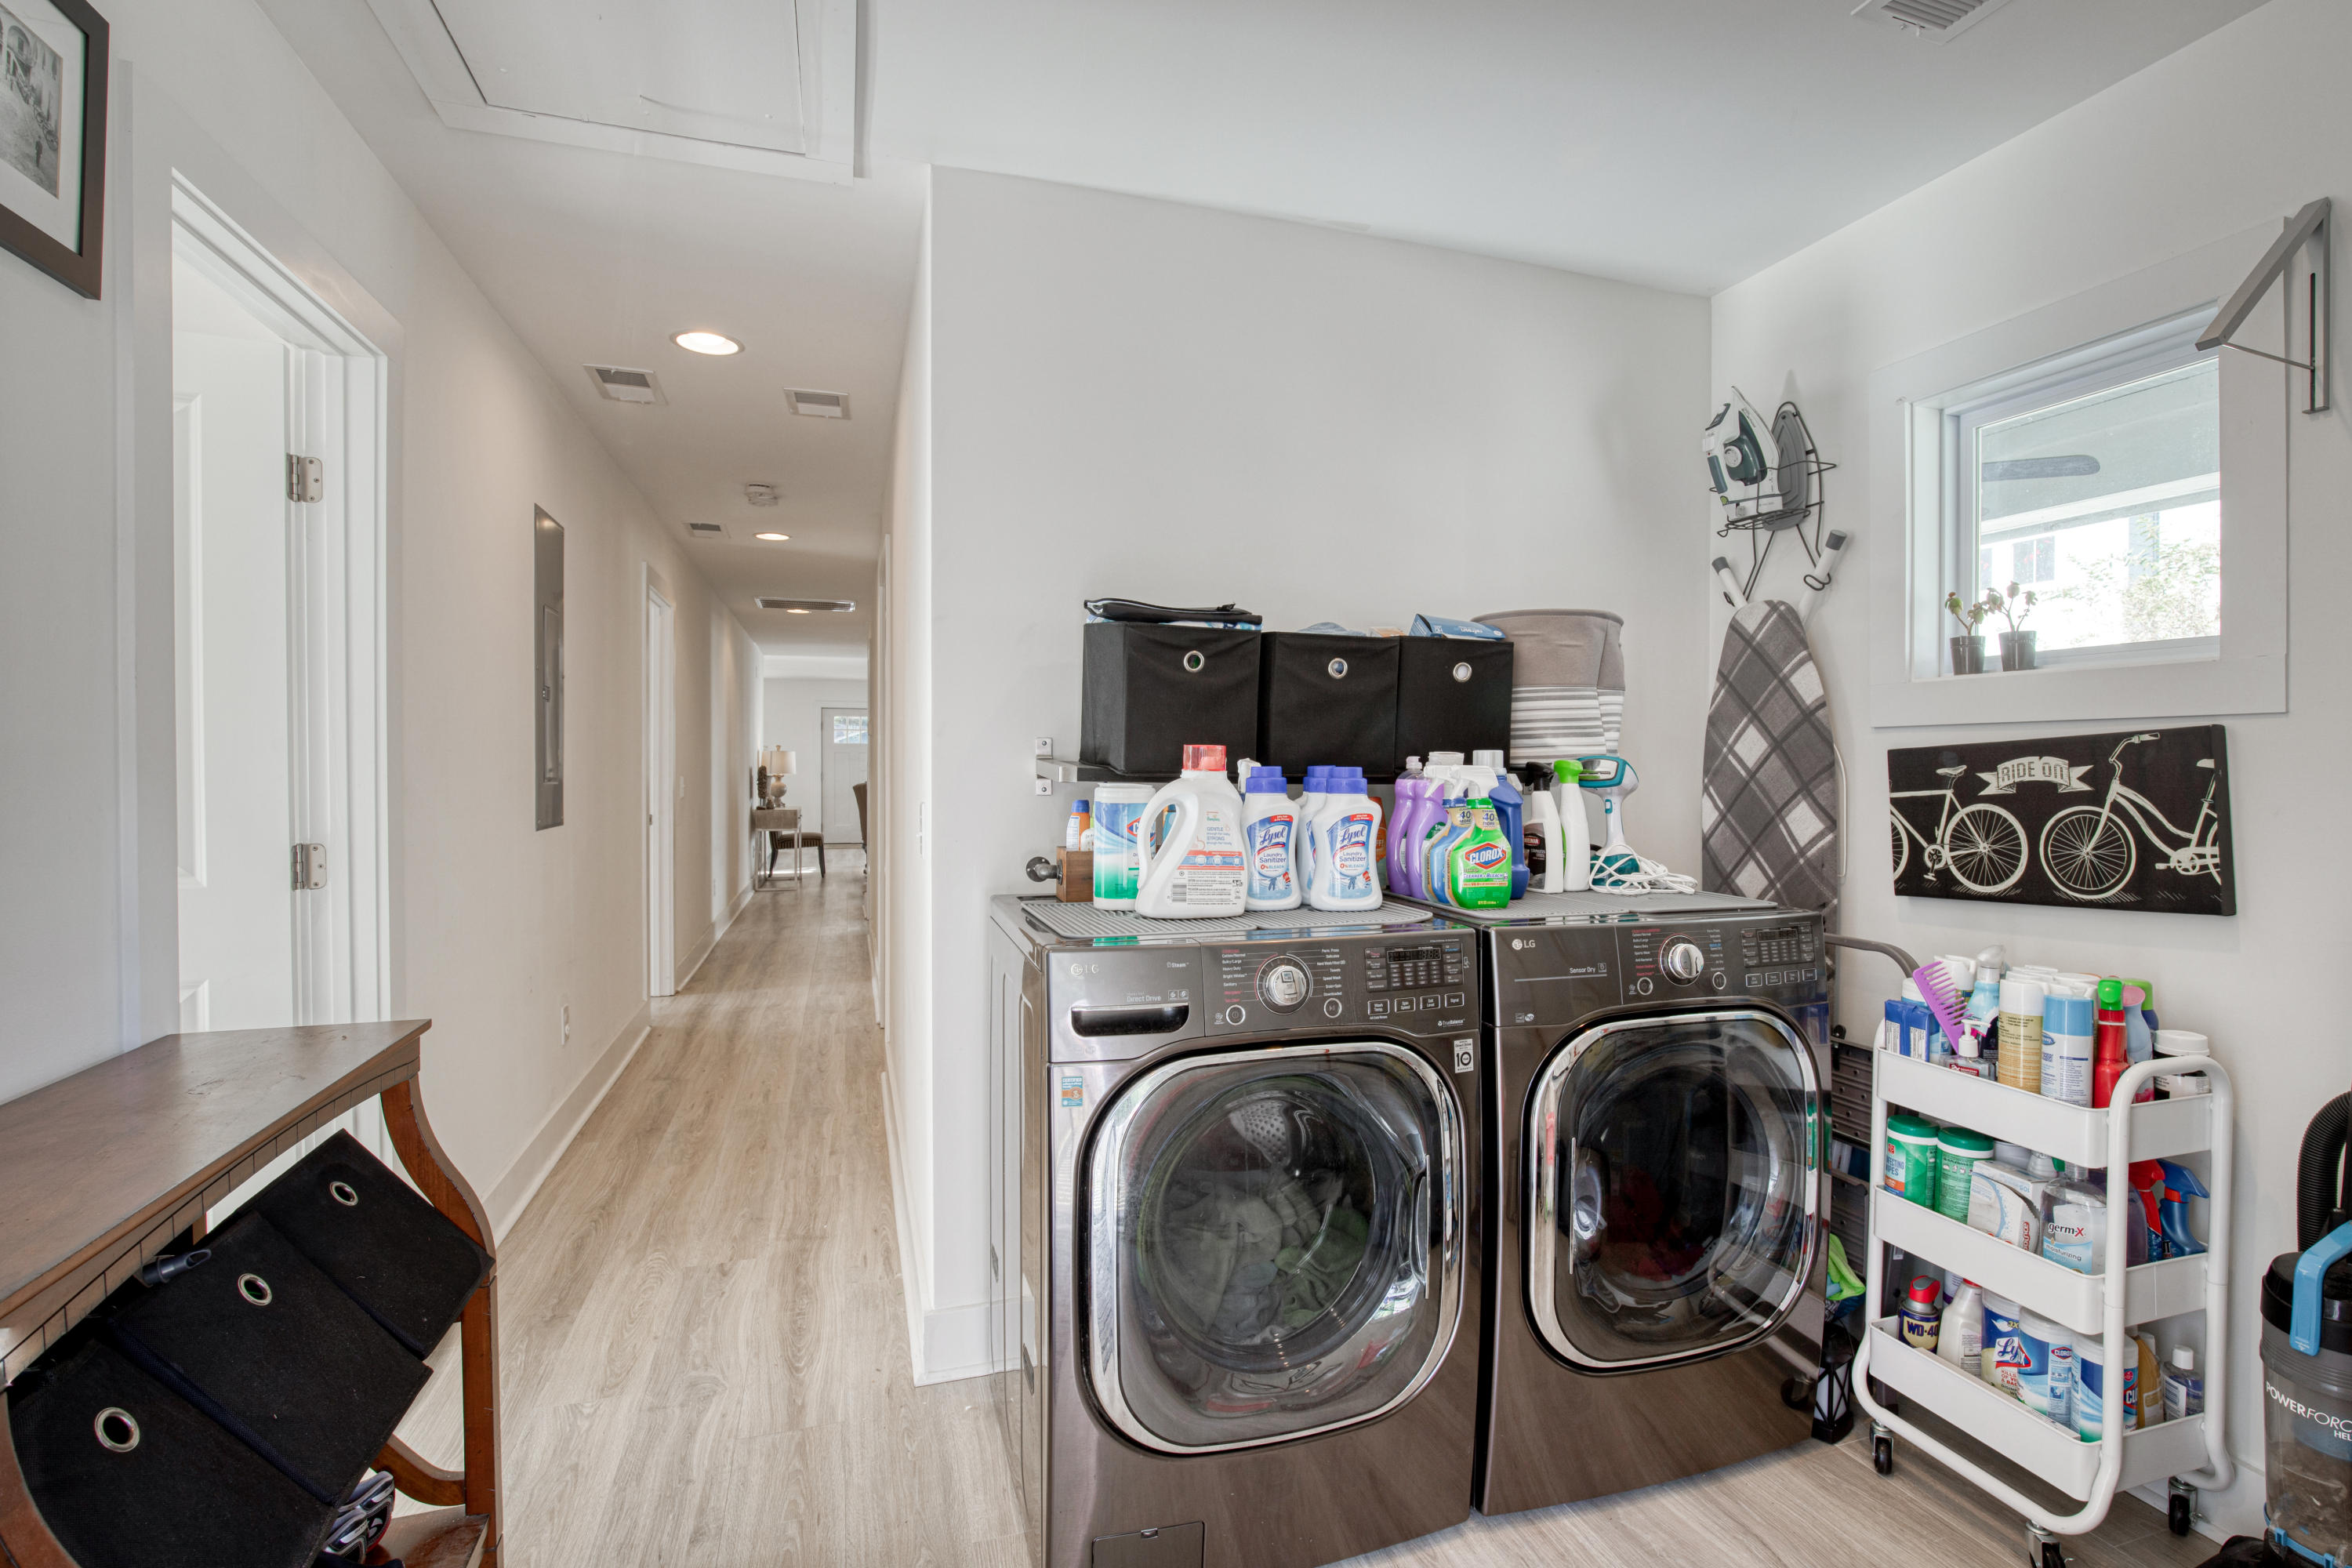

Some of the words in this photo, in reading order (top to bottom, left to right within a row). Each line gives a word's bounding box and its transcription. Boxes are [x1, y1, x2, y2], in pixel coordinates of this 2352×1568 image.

[2001, 761, 2035, 782] RIDE
[2042, 762, 2064, 779] ON
[1260, 827, 1286, 845] Lysol
[1339, 826, 1366, 844] Lysol
[1469, 848, 1503, 865] CLOROX
[1456, 1051, 1472, 1067] 10
[2049, 1223, 2085, 1236] germ-X
[2045, 1244, 2082, 1261] moisturizing
[1907, 1321, 1939, 1338] WD-40
[2008, 1320, 2019, 1329] 3X
